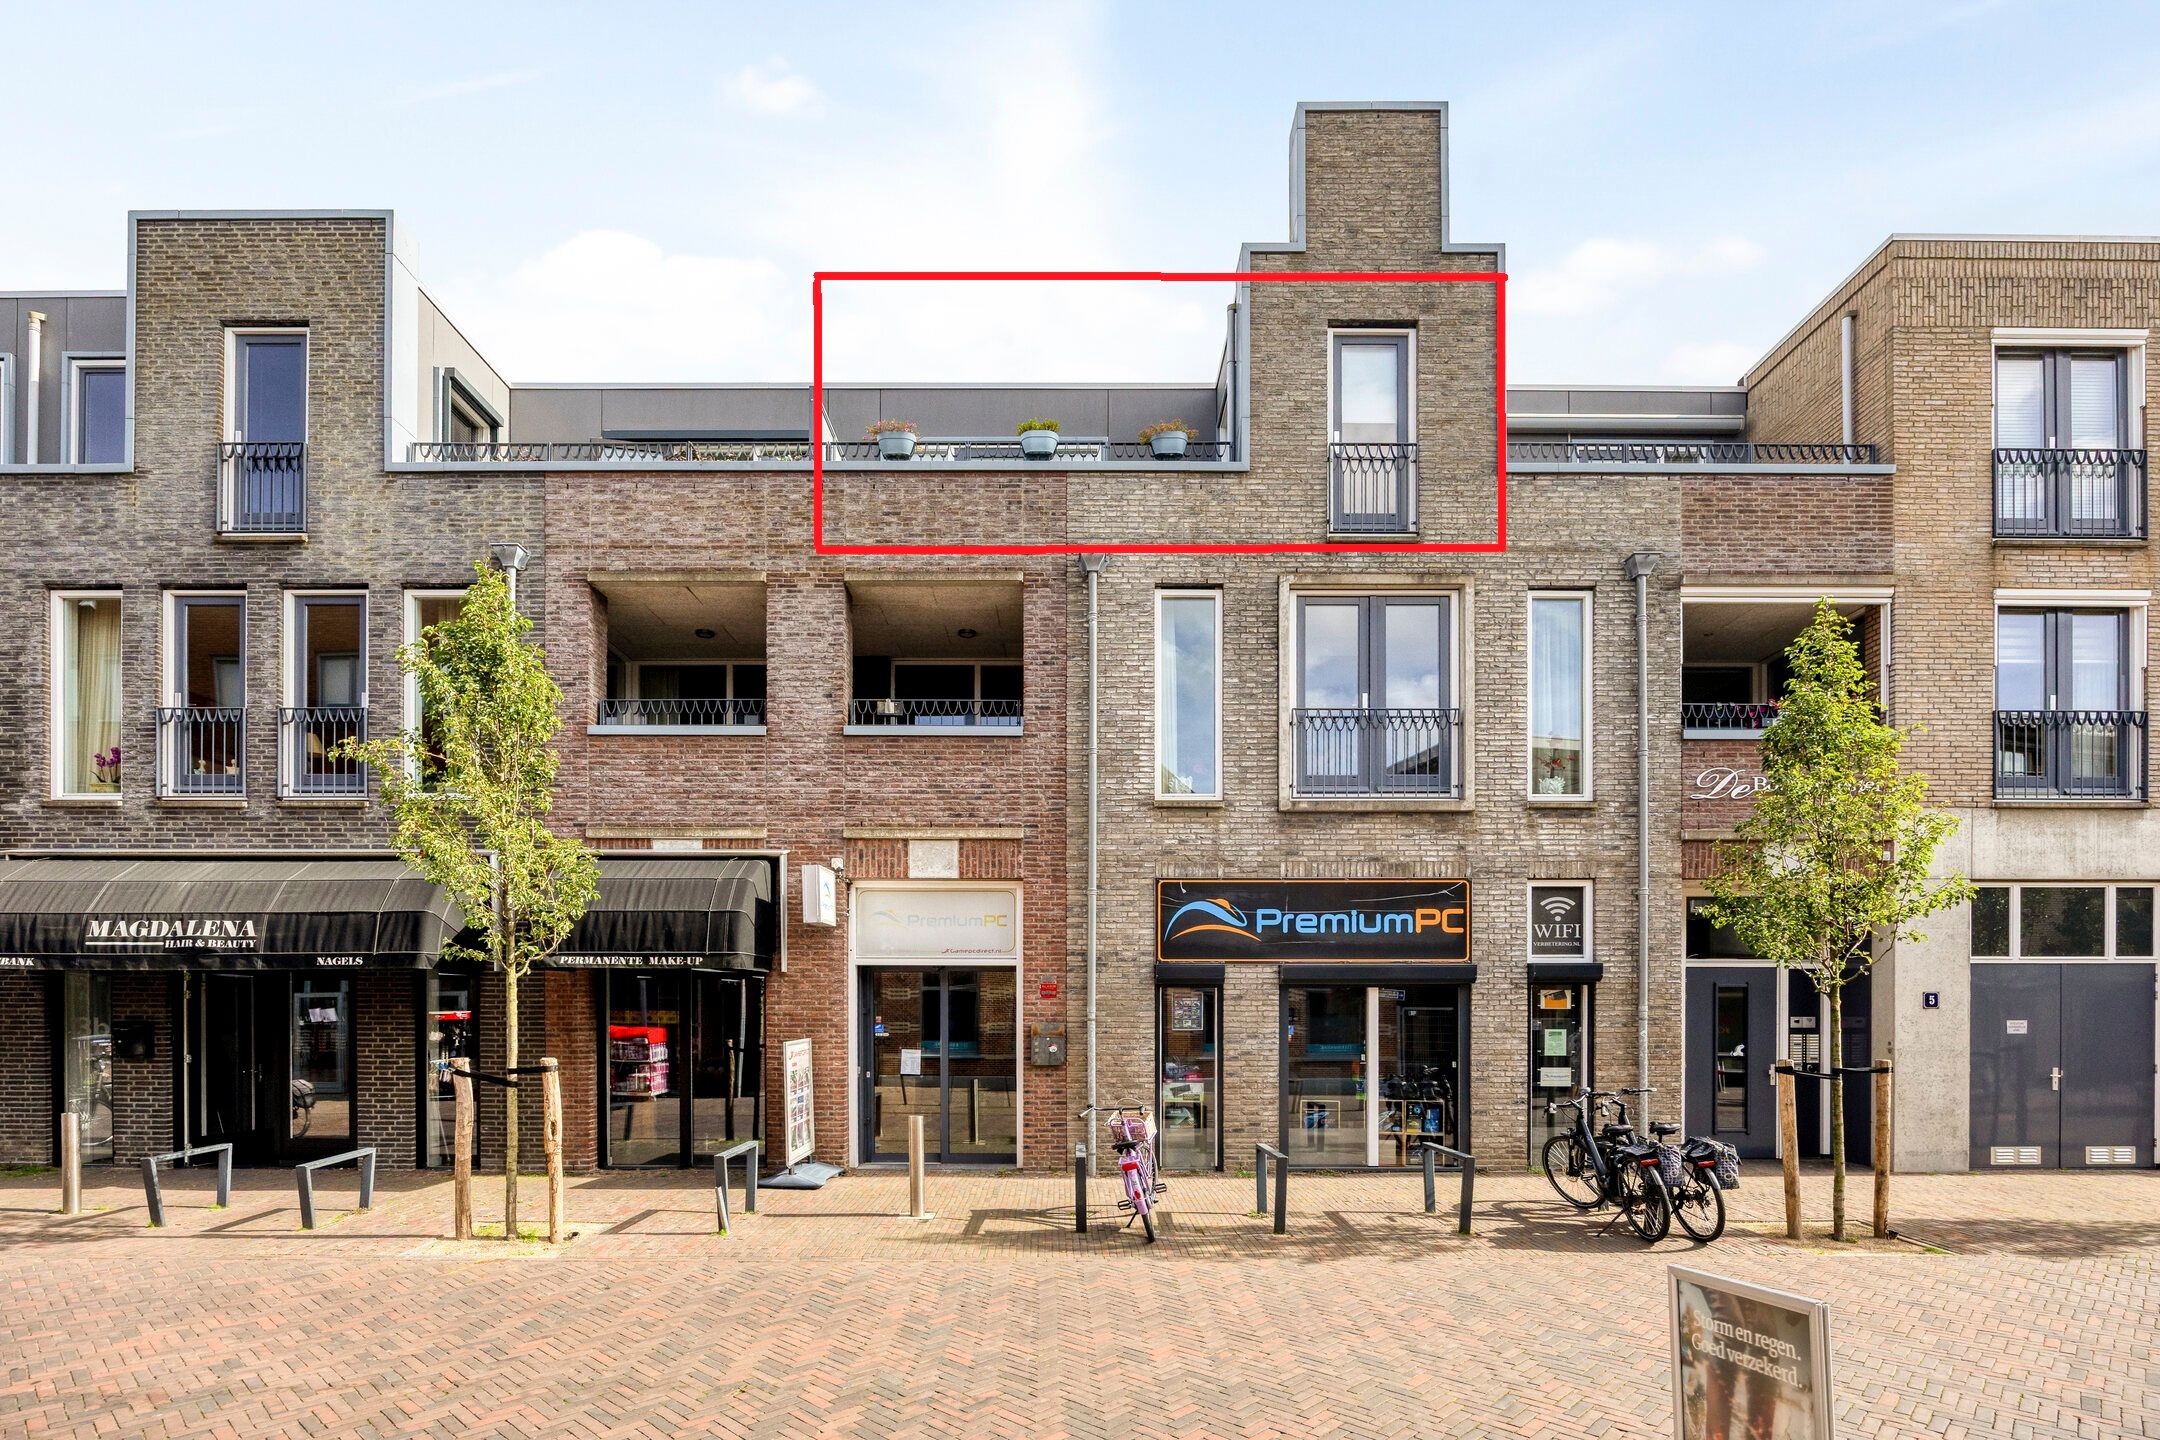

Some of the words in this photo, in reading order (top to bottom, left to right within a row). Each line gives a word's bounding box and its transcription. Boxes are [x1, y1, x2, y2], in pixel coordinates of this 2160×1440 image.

[1690, 767, 1755, 800] De
[907, 914, 1008, 927] PremiumPC
[1256, 908, 1464, 934] PremiumPC
[86, 920, 257, 938] MAGDALENA
[1533, 923, 1581, 938] WIFI
[165, 939, 193, 948] HAIR
[195, 939, 205, 948] &
[207, 939, 257, 949] BEAUTY
[0, 957, 35, 966] BANK
[316, 956, 364, 966] NAGELS
[559, 956, 643, 965] PERMANENTE
[649, 956, 703, 966] MAKE-UP
[1929, 995, 1935, 1005] 5
[1693, 1310, 1734, 1338] Storm
[1735, 1326, 1752, 1344] en
[1754, 1332, 1801, 1361] regen.
[1691, 1333, 1725, 1360] Goed
[1726, 1347, 1803, 1389] verzekerd.
